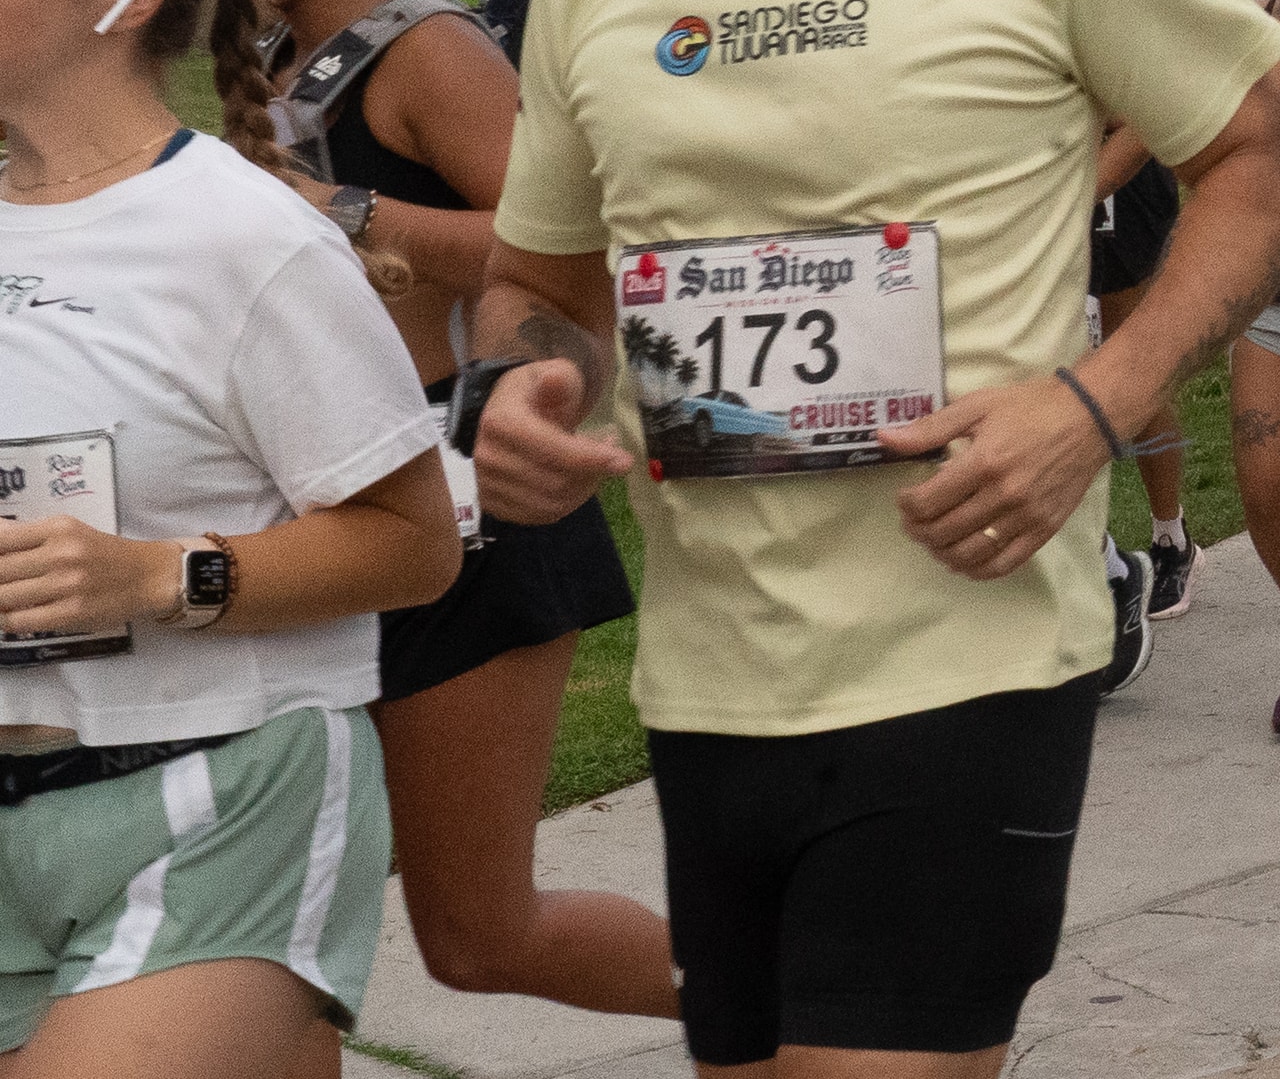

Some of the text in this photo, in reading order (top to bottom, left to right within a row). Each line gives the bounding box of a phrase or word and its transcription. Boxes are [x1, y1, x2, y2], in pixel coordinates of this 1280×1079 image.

[717, 28, 868, 65] TIJUANA RACE
[676, 256, 748, 301] San
[756, 254, 856, 294] Diego
[695, 308, 841, 398] 173
[789, 393, 935, 431] CRUISE RUN
